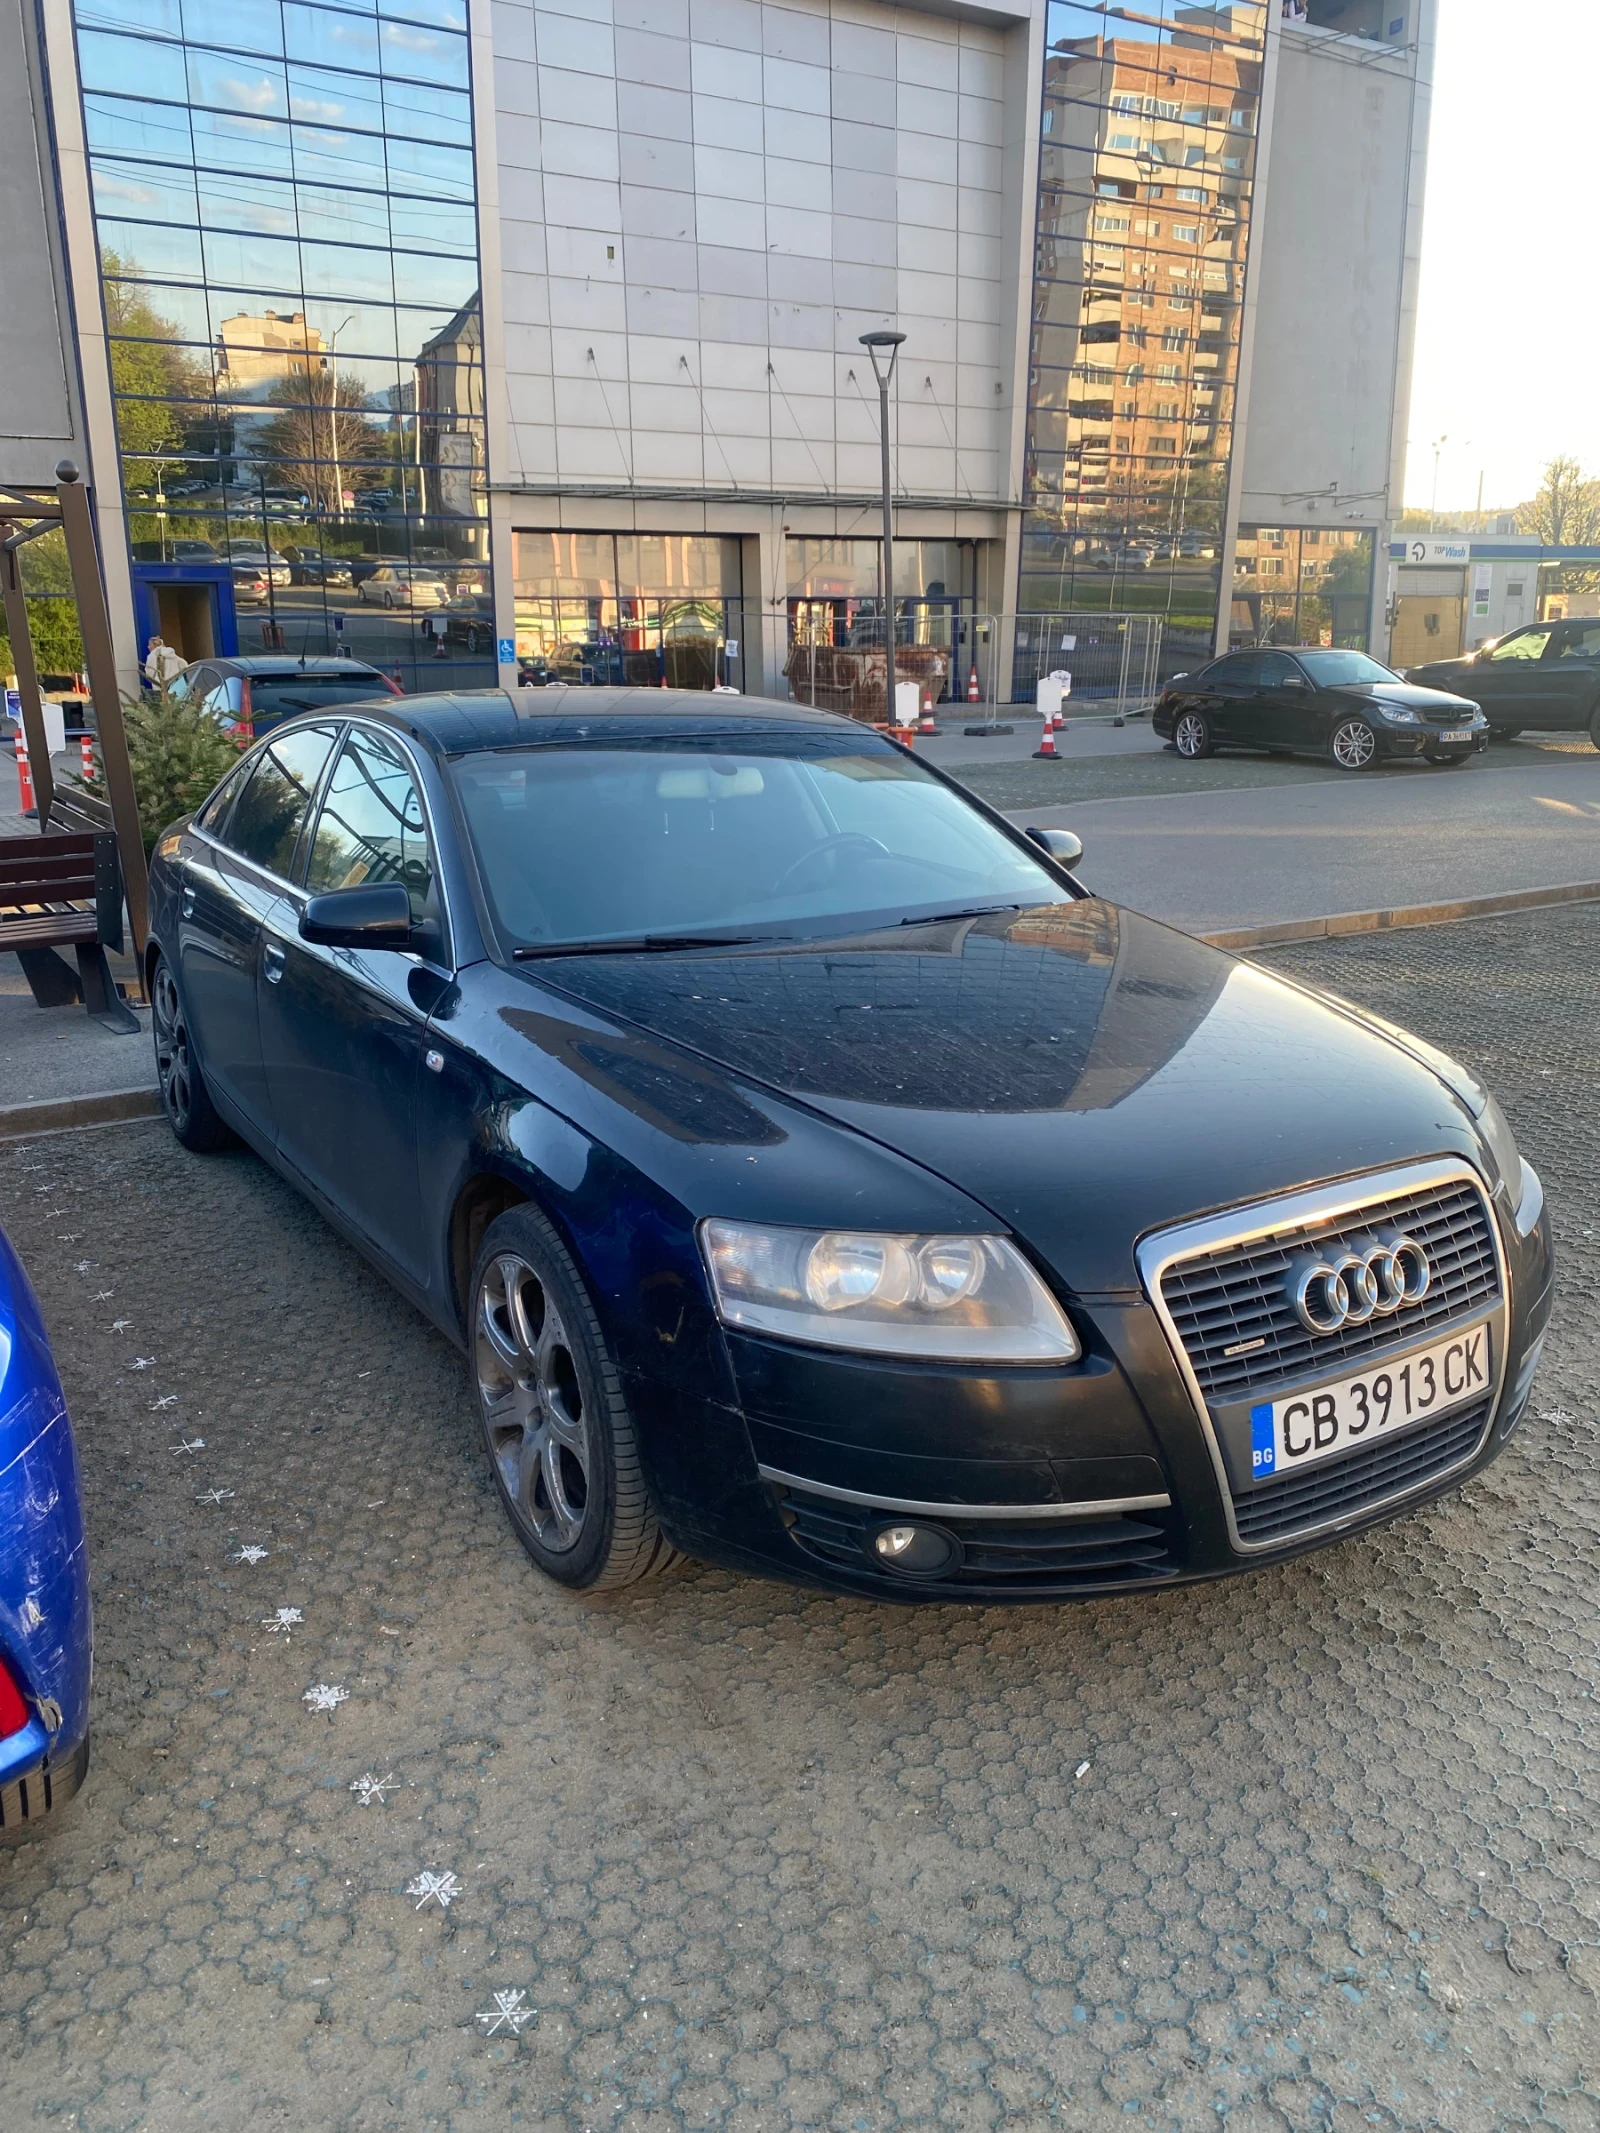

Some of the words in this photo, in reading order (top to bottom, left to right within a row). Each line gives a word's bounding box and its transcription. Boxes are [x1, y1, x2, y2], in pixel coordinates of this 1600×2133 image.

[1283, 1394, 1338, 1457] CB
[1349, 1356, 1436, 1435] 3913
[1444, 1332, 1484, 1395] CK
[1253, 1447, 1273, 1467] BG
